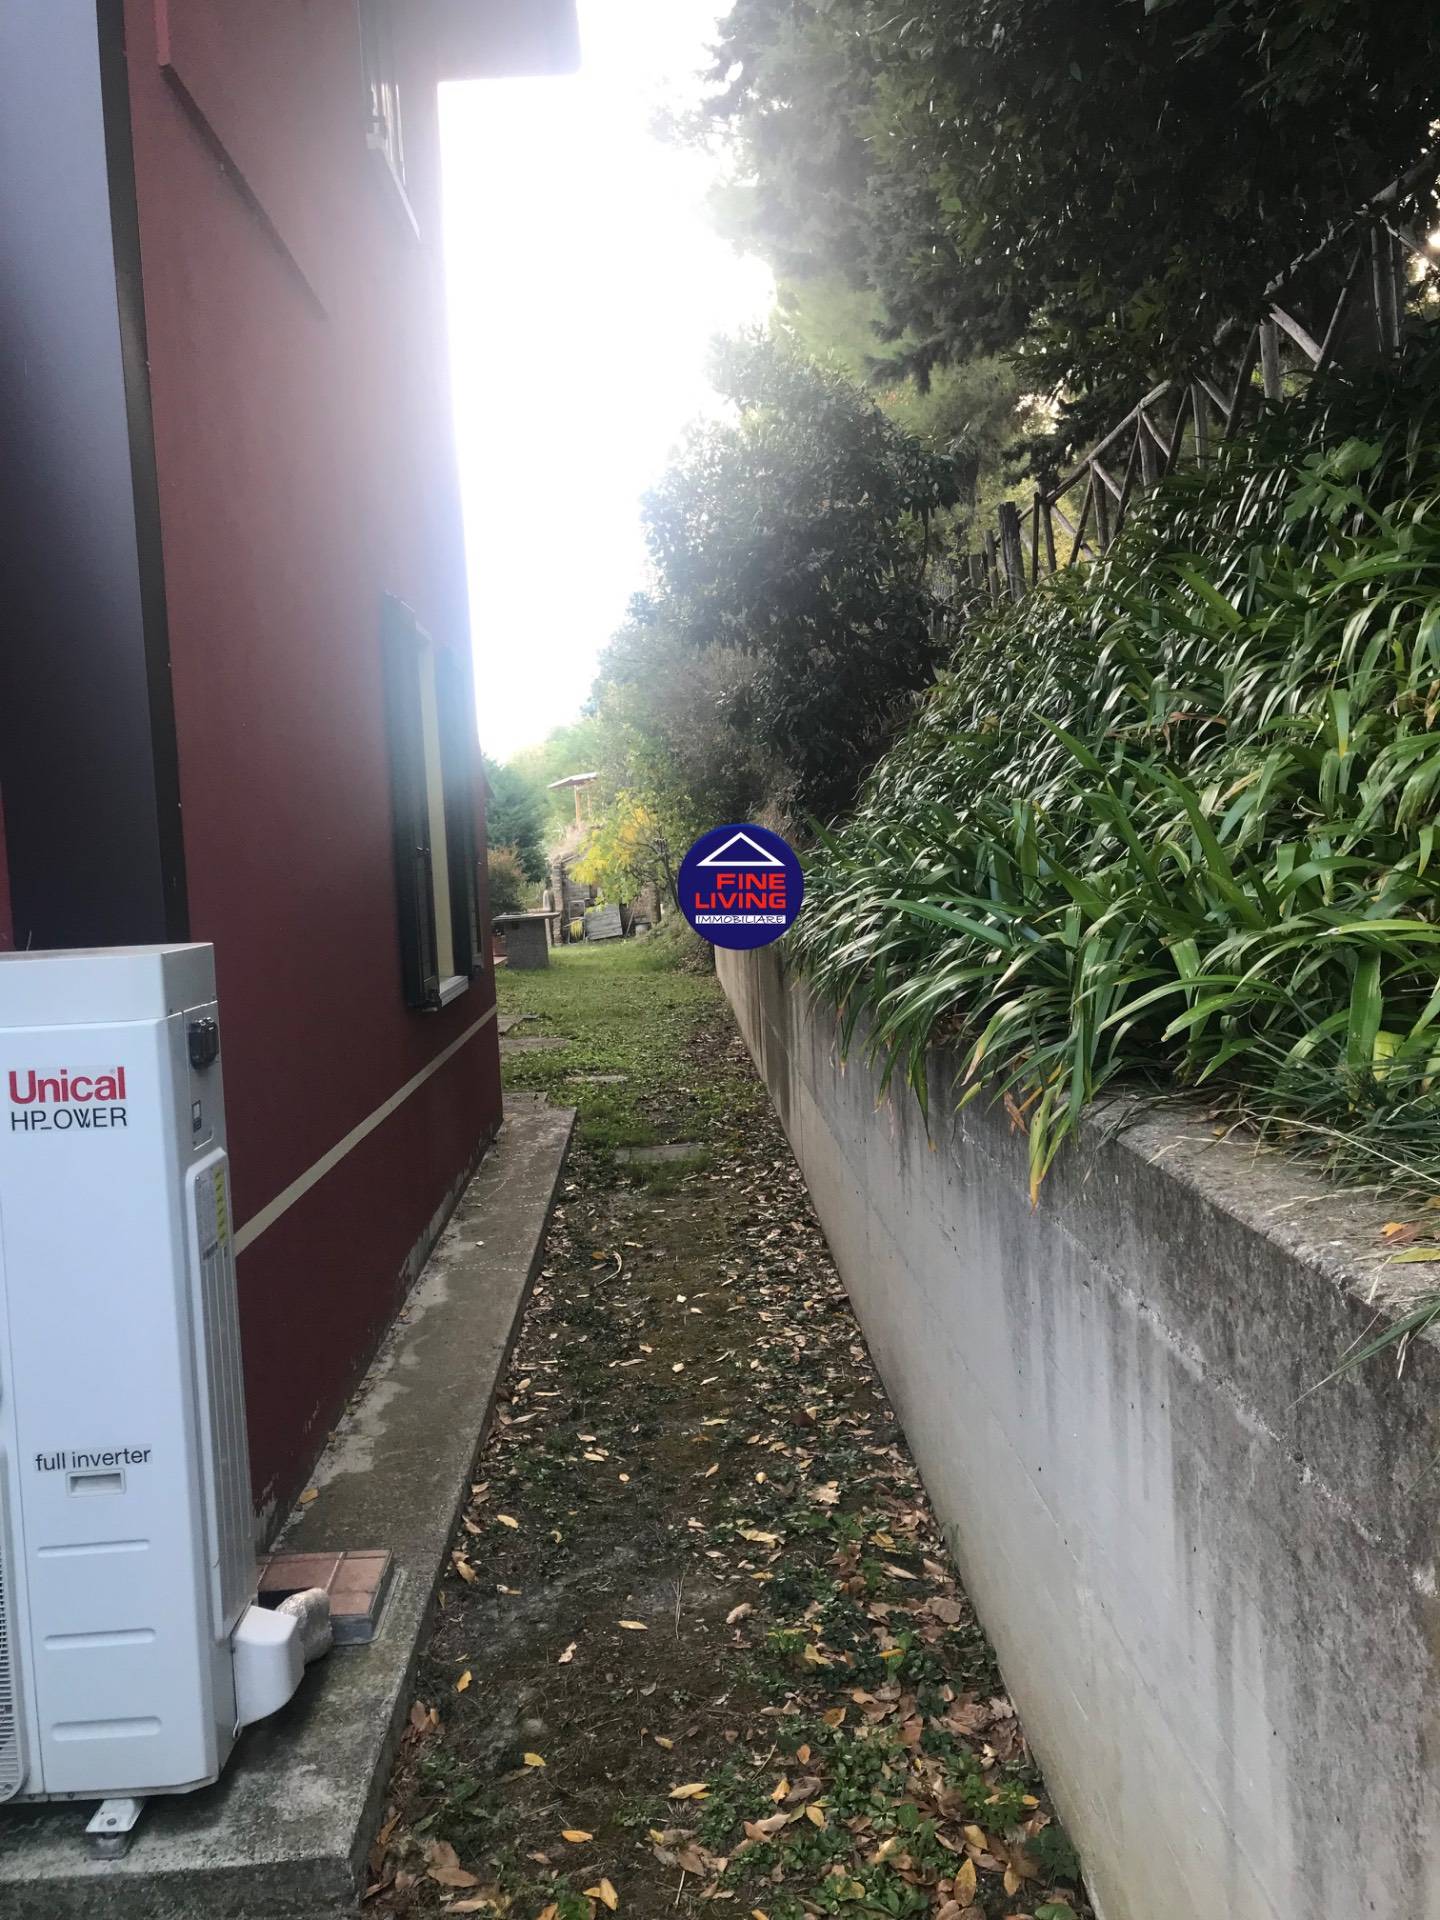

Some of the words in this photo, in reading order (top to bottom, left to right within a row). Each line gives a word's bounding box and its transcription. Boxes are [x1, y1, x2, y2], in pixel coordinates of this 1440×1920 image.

[8, 1067, 126, 1104] Unical
[35, 1453, 66, 1471] full
[72, 1448, 151, 1468] inverter
